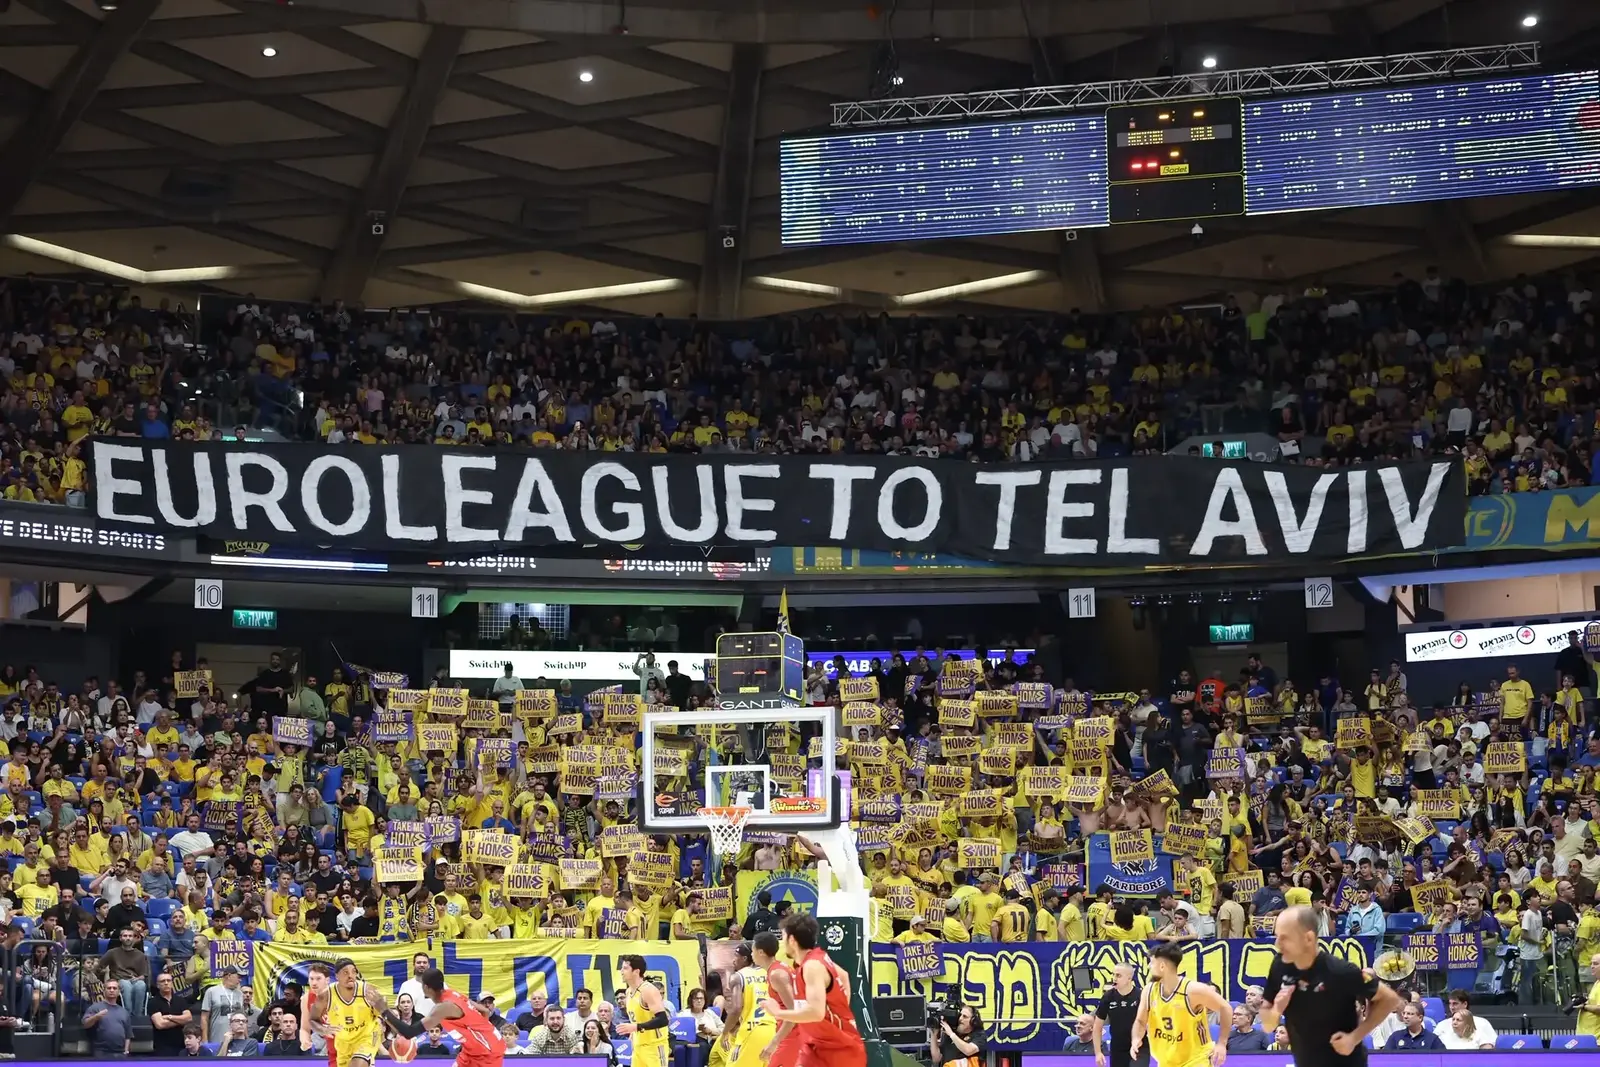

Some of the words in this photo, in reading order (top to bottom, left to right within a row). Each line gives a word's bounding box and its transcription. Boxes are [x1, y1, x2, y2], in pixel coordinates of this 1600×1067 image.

[1162, 165, 1188, 174] Bodet
[94, 441, 780, 542] EUROLEAGUE
[809, 464, 942, 541] TO
[976, 468, 1159, 555] TEL
[1190, 463, 1450, 555] AVIV
[20, 522, 93, 544] DELIVER
[98, 530, 165, 550] SPORTS
[196, 584, 222, 607] 10
[1307, 584, 1332, 606] 12
[416, 593, 434, 616] 11
[1073, 593, 1092, 616] 11
[544, 660, 587, 670] Switchup
[180, 672, 194, 680] TAKE
[195, 671, 206, 679] ME
[609, 695, 625, 703] TAKE
[626, 695, 636, 703] ME
[719, 700, 780, 710] GANT
[280, 717, 297, 726] TAKE
[298, 718, 308, 727] ME
[378, 713, 395, 722] TAKE
[396, 713, 406, 722] ME
[1000, 724, 1015, 732] TAKE
[1016, 724, 1026, 732] ME
[1342, 719, 1354, 727] TAKE
[1355, 719, 1364, 727] ME
[482, 740, 500, 748] TAKE
[501, 740, 511, 748] ME
[590, 737, 605, 745] TAKE
[606, 737, 616, 746] ME
[1072, 740, 1088, 748] TAKE
[1089, 739, 1098, 747] ME
[1490, 744, 1506, 752] TAKE
[1507, 743, 1518, 751] ME
[1212, 749, 1227, 758] TAKE
[1228, 748, 1238, 757] ME
[568, 765, 584, 775] TAKE
[586, 766, 596, 775] ME
[935, 767, 952, 775] TAKE
[954, 768, 964, 776] ME
[1031, 768, 1047, 776] TAKE
[1049, 768, 1060, 776] ME
[1073, 777, 1089, 785] TAKE
[1090, 777, 1100, 785] ME
[1423, 791, 1438, 799] TAKE
[1440, 790, 1452, 799] ME
[210, 801, 226, 810] TAKE
[227, 802, 237, 811] ME
[776, 802, 811, 811] Winner
[393, 822, 411, 832] TAKE
[413, 822, 424, 832] ME
[605, 827, 619, 836] ONE
[620, 825, 640, 835] LEAGU
[1168, 825, 1182, 834] ONE
[1183, 827, 1206, 838] LEAGUE
[482, 834, 499, 843] TAKE
[502, 835, 513, 843] ME
[1116, 832, 1132, 841] TAKE
[1134, 831, 1144, 839] ME
[382, 849, 401, 859] TAKE
[403, 849, 414, 858] ME
[634, 852, 648, 862] ONE
[649, 853, 672, 864] LEAGUE
[512, 865, 528, 874] TAKE
[530, 865, 541, 874] ME
[1049, 864, 1065, 873] TAKE
[1067, 864, 1078, 873] ME
[1104, 876, 1167, 893] HARDCORE
[1011, 912, 1025, 932] 11
[544, 928, 562, 938] TAKE
[565, 928, 577, 938] ME
[1409, 935, 1425, 945] TAKE
[1427, 935, 1436, 945] ME
[1449, 934, 1464, 944] TAKE
[1466, 933, 1475, 944] ME
[217, 941, 233, 951] TAKE
[234, 941, 247, 951] ME
[903, 945, 923, 957] TAKE
[924, 943, 935, 954] ME
[345, 1016, 355, 1025] 5
[1162, 1017, 1173, 1030] 3
[1154, 1028, 1183, 1045] Rapyd
